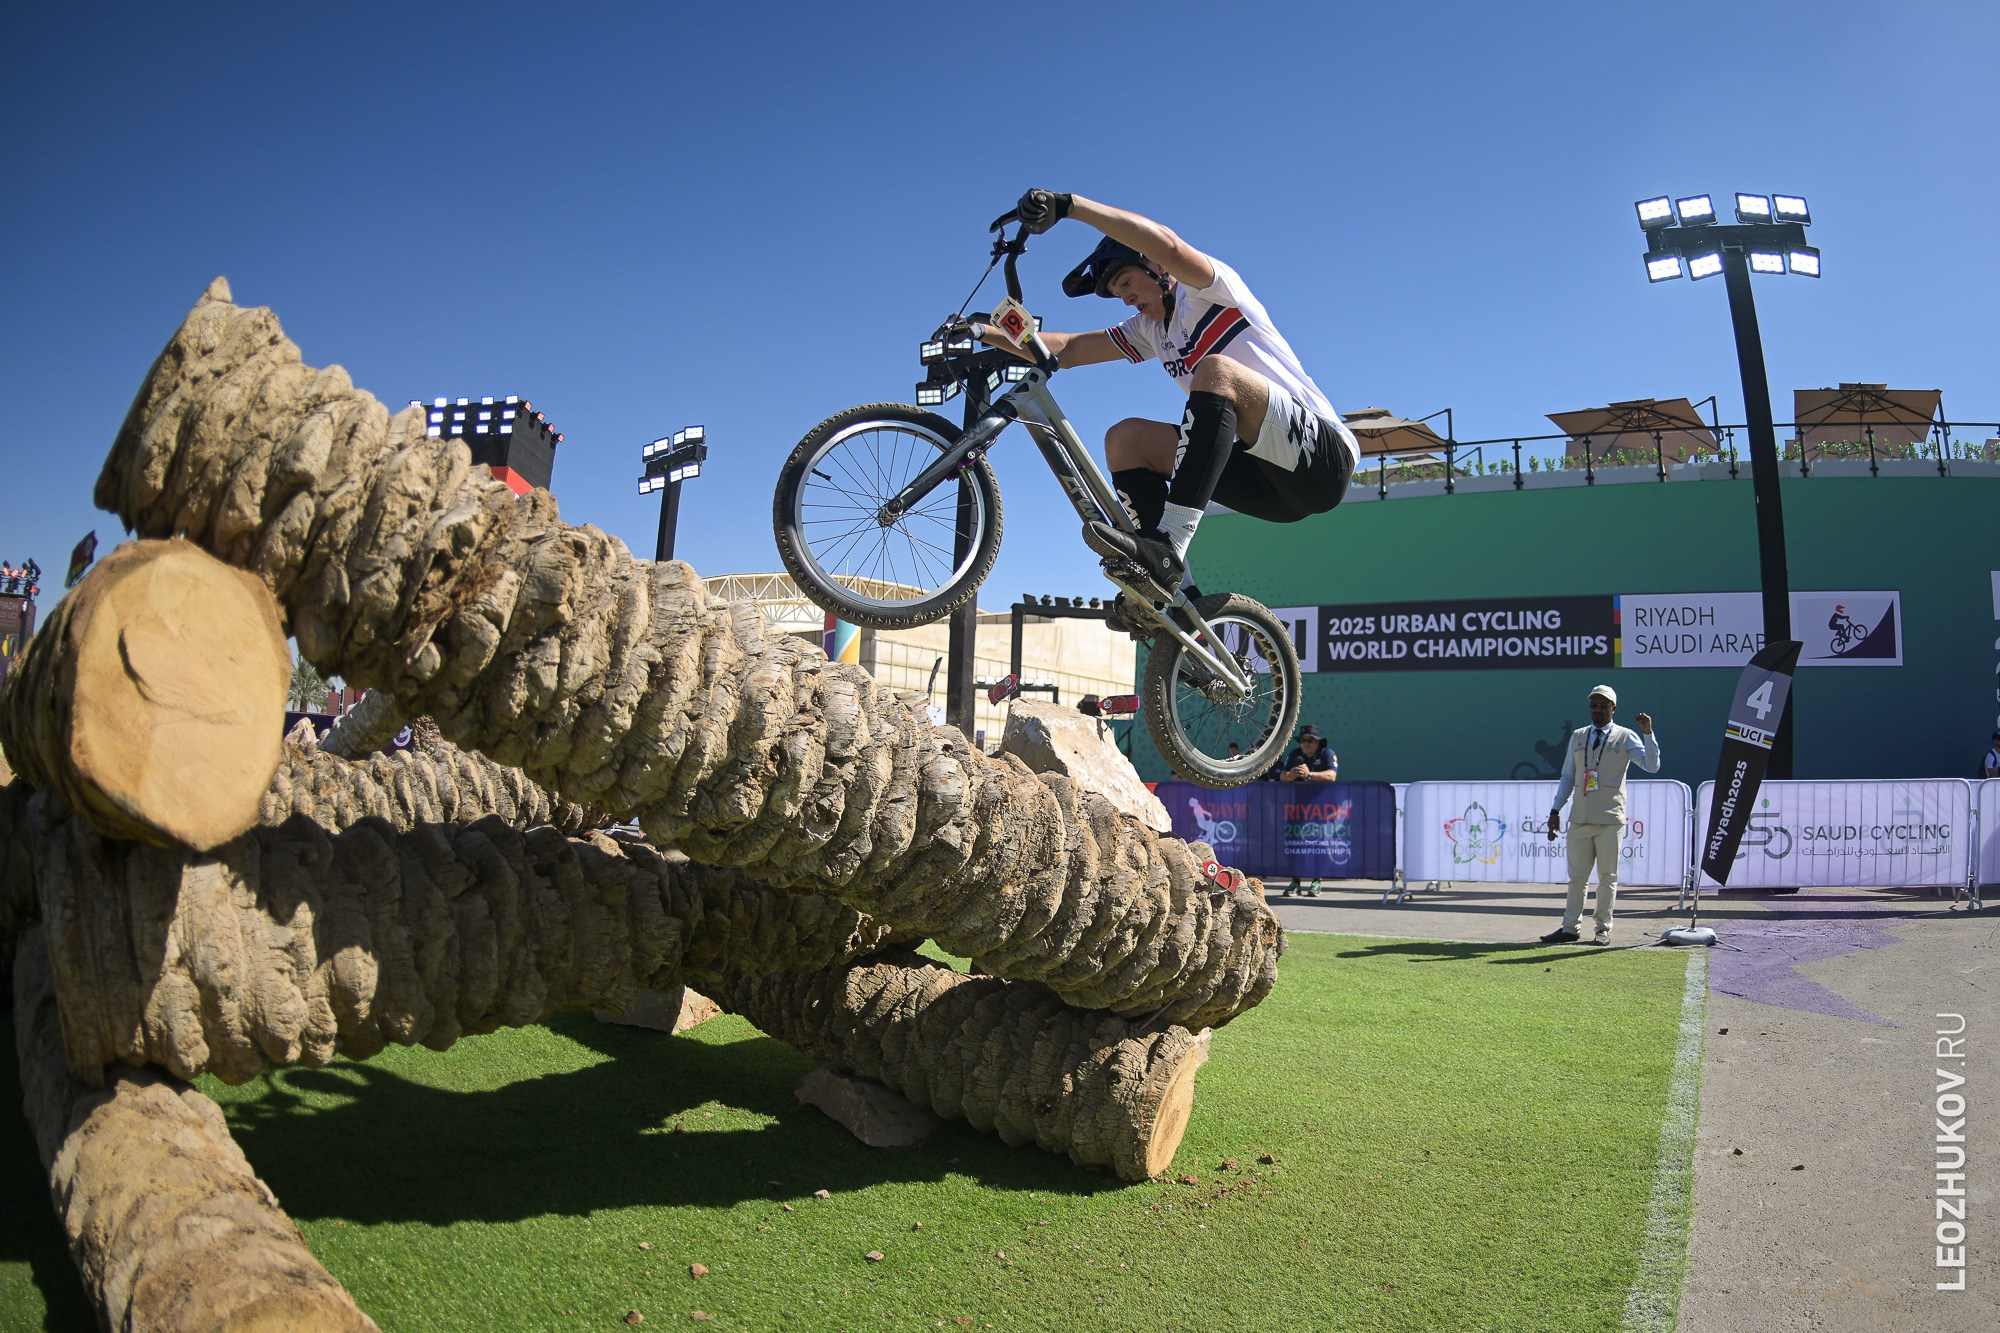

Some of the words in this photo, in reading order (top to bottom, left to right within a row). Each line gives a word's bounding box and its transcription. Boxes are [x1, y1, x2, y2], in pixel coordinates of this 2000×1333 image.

[1329, 617, 1375, 636] 2025
[1381, 613, 1456, 633] URBAN
[1462, 610, 1561, 632] CYCLING
[1635, 606, 1715, 627] RIYADH
[1328, 640, 1407, 660] WORLD
[1413, 635, 1608, 659] CHAMPIONSHIPS
[1635, 634, 1703, 655] SAUDI
[1746, 680, 1774, 721] 4
[1739, 727, 1762, 744] UCI
[1284, 803, 1351, 821] RIYADH
[1708, 760, 1748, 860] #Riyadh2025
[1324, 823, 1351, 837] UCI
[1803, 825, 1862, 841] SAUDI
[1870, 824, 1951, 841] CYCLING
[1284, 847, 1351, 855] CHAMPIONSHIPS
[1520, 842, 1567, 858] Ministr
